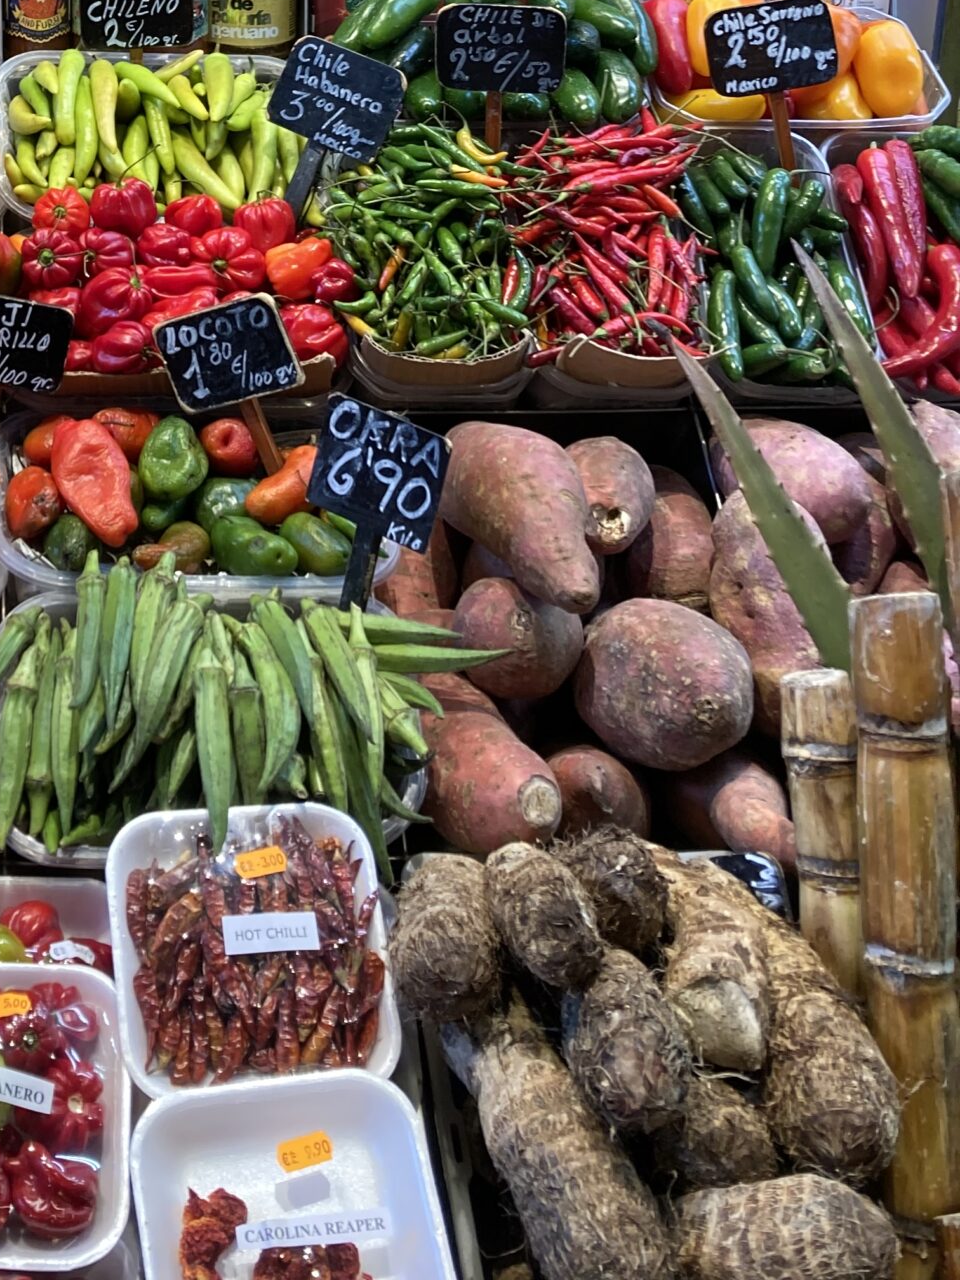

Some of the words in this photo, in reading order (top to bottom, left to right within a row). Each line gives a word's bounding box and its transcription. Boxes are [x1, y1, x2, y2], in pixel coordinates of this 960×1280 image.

[459, 5, 523, 25] CHILE
[531, 11, 557, 29] DE
[211, 24, 279, 40] peruano
[297, 42, 351, 77] Chile
[294, 64, 384, 115] Habanero
[329, 400, 441, 479] OKRA
[386, 521, 424, 551] Kilo
[235, 929, 263, 942] HOT
[266, 926, 309, 941] CHILLI
[244, 1221, 321, 1244] CAROLINA
[325, 1217, 386, 1236] REAPER
